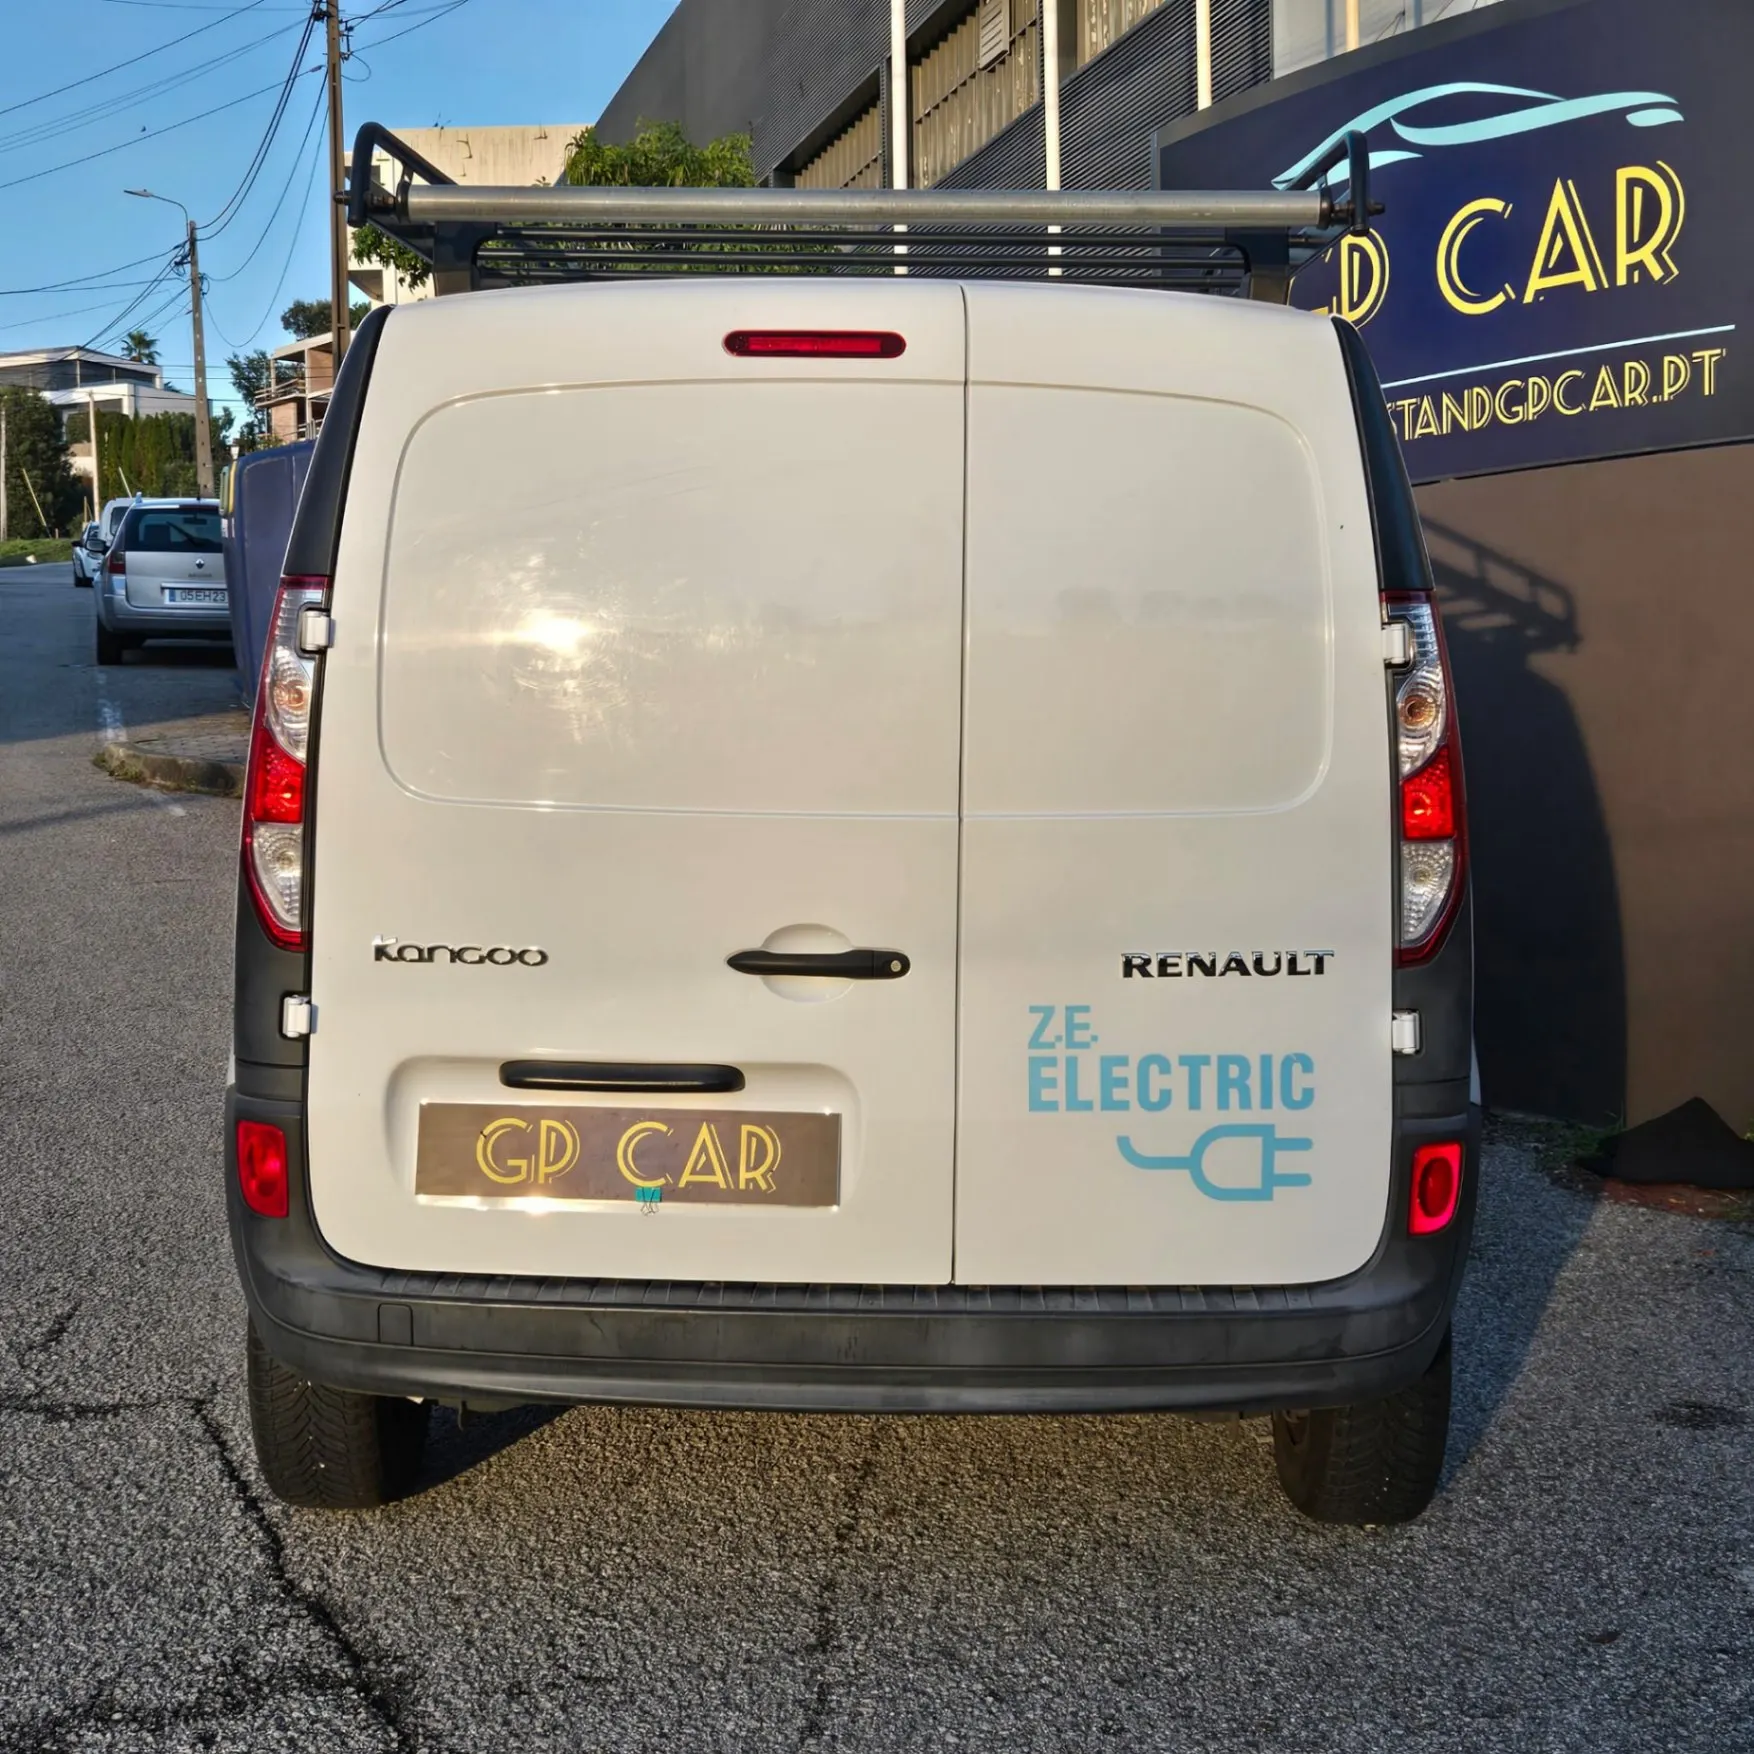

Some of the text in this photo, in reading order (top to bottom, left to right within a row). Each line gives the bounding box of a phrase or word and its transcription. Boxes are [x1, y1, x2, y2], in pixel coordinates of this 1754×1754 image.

[1288, 160, 1686, 330] P CAR
[1121, 950, 1334, 978] RENAULT
[1028, 1005, 1099, 1049] Z.E.
[1028, 1052, 1315, 1112] ELECTRIC
[476, 1117, 782, 1193] GP CAR
